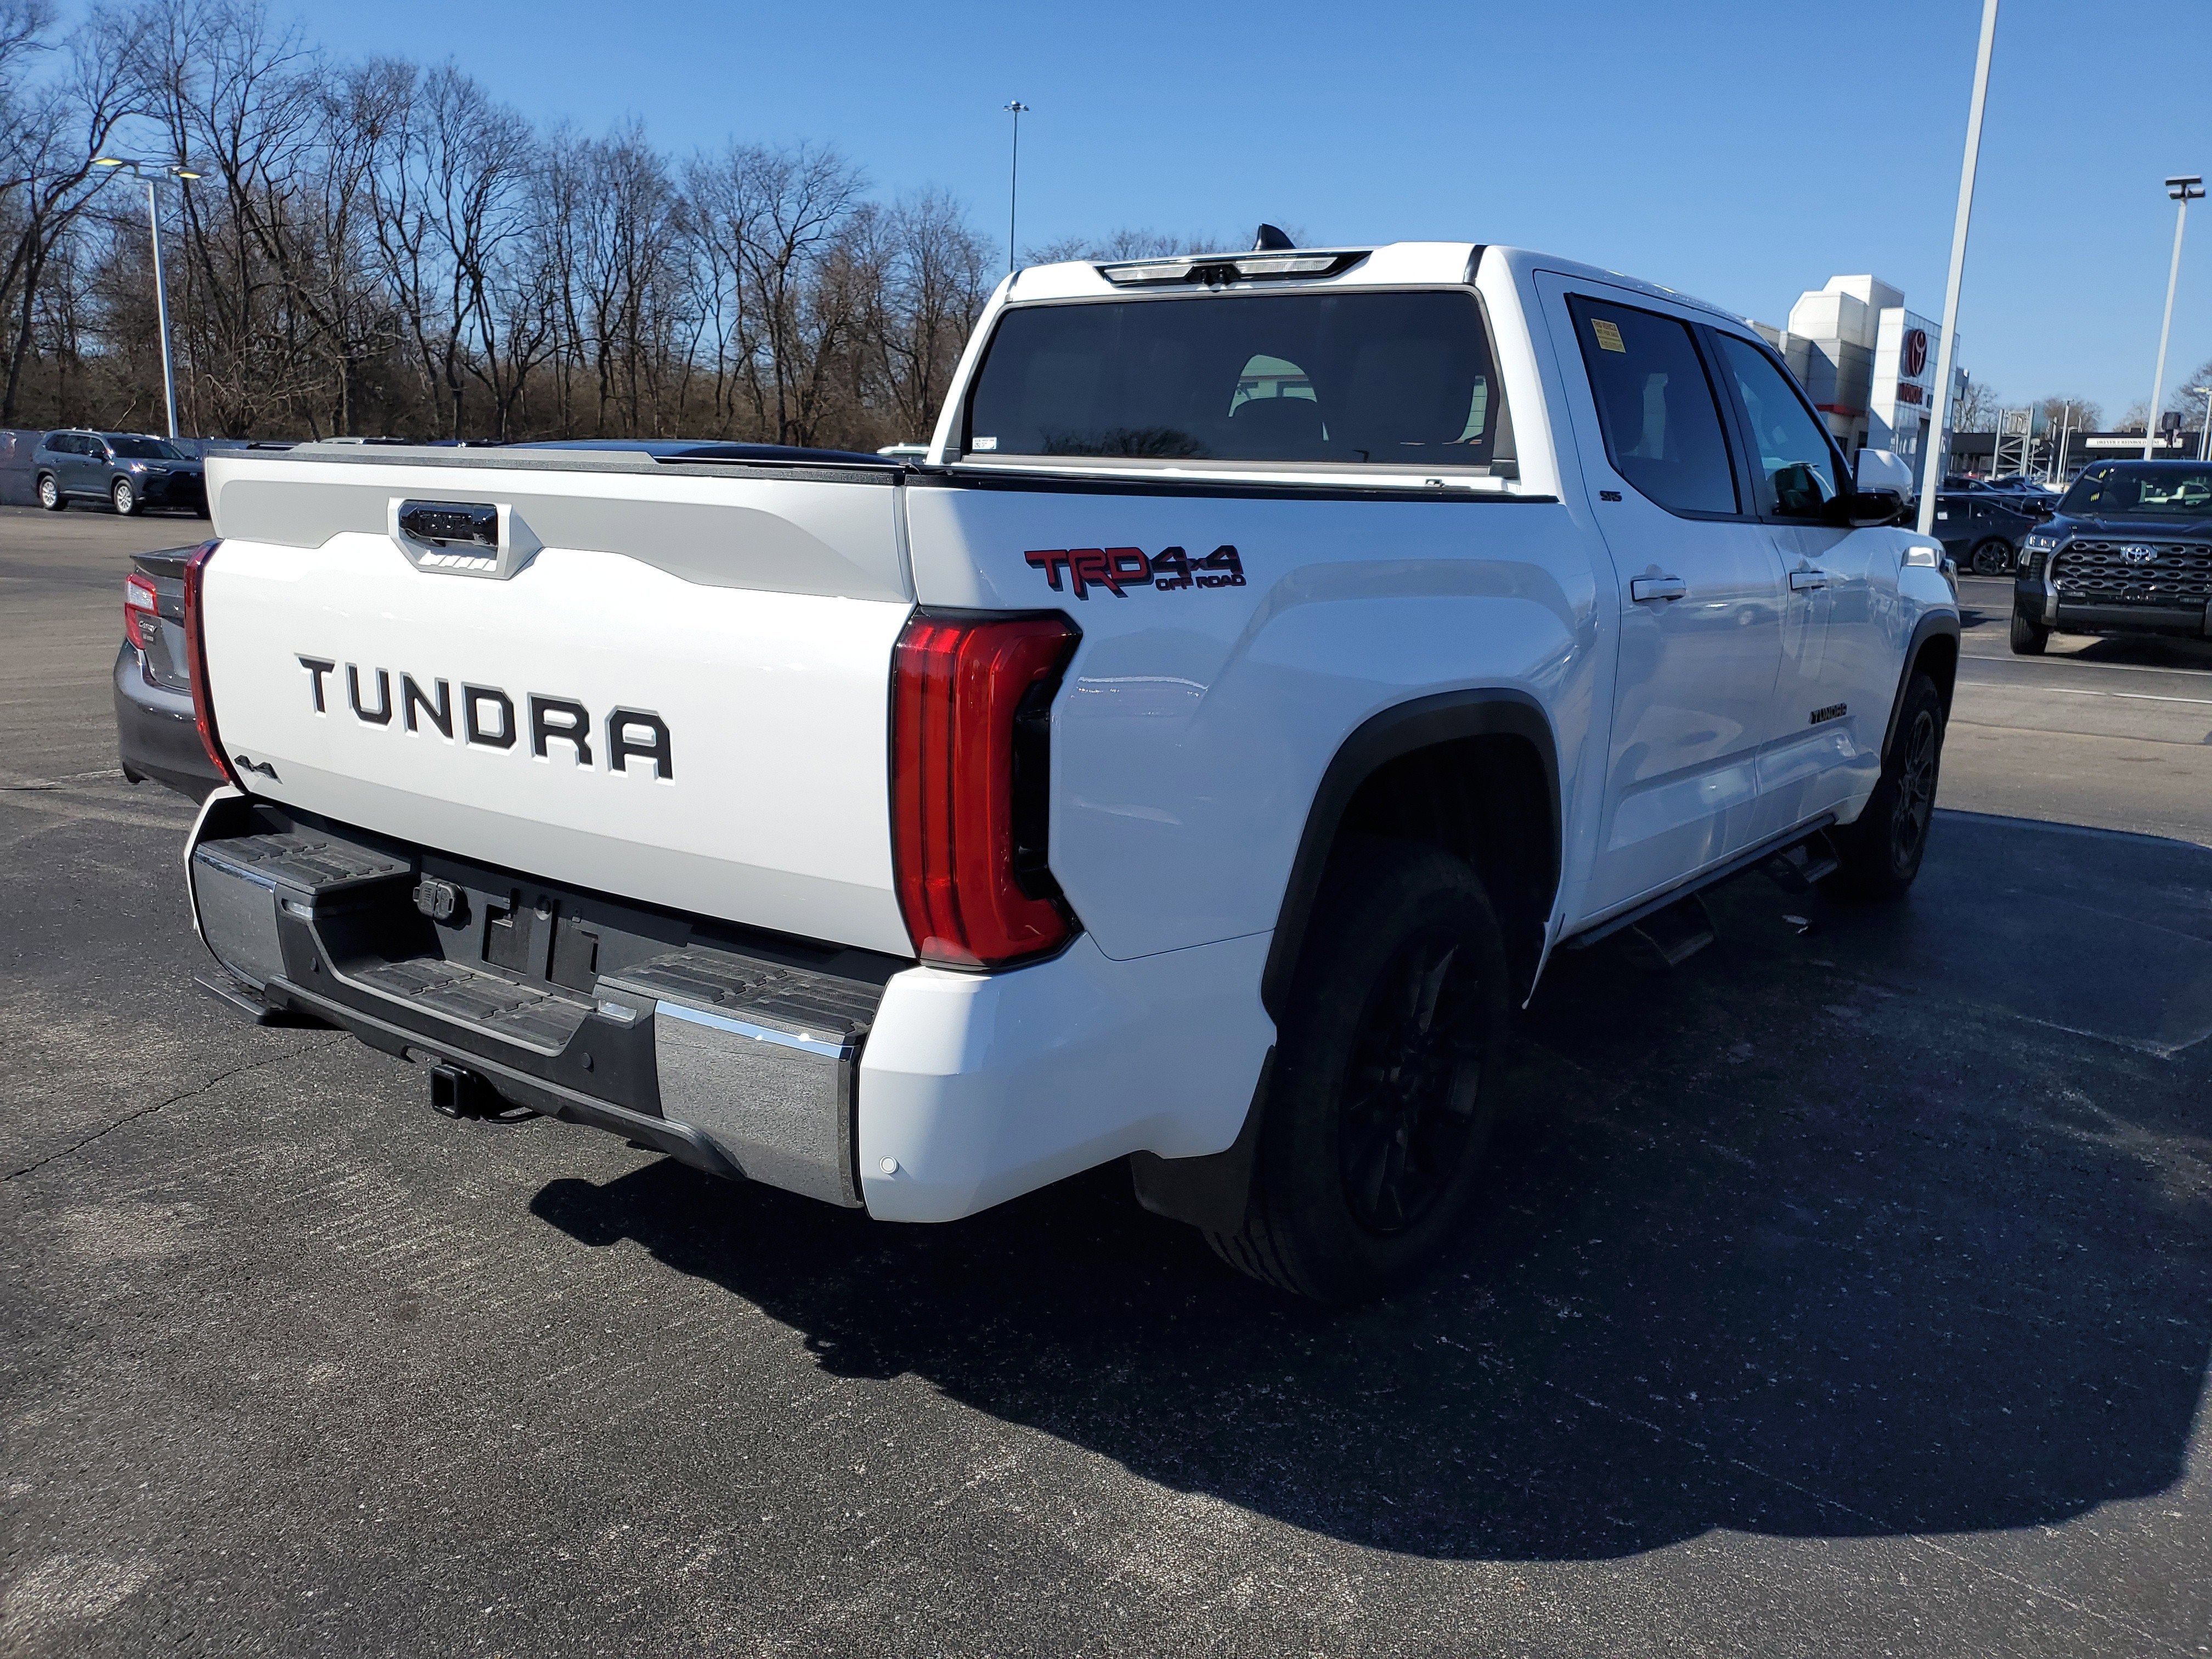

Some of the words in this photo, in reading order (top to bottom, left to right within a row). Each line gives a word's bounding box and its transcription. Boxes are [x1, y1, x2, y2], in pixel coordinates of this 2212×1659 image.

[1024, 547, 1154, 600] TRD
[1155, 576, 1194, 591] OFF
[1195, 574, 1246, 589] ROAD
[295, 653, 675, 785] TUNDRA
[1810, 702, 1847, 725] TUNDRA
